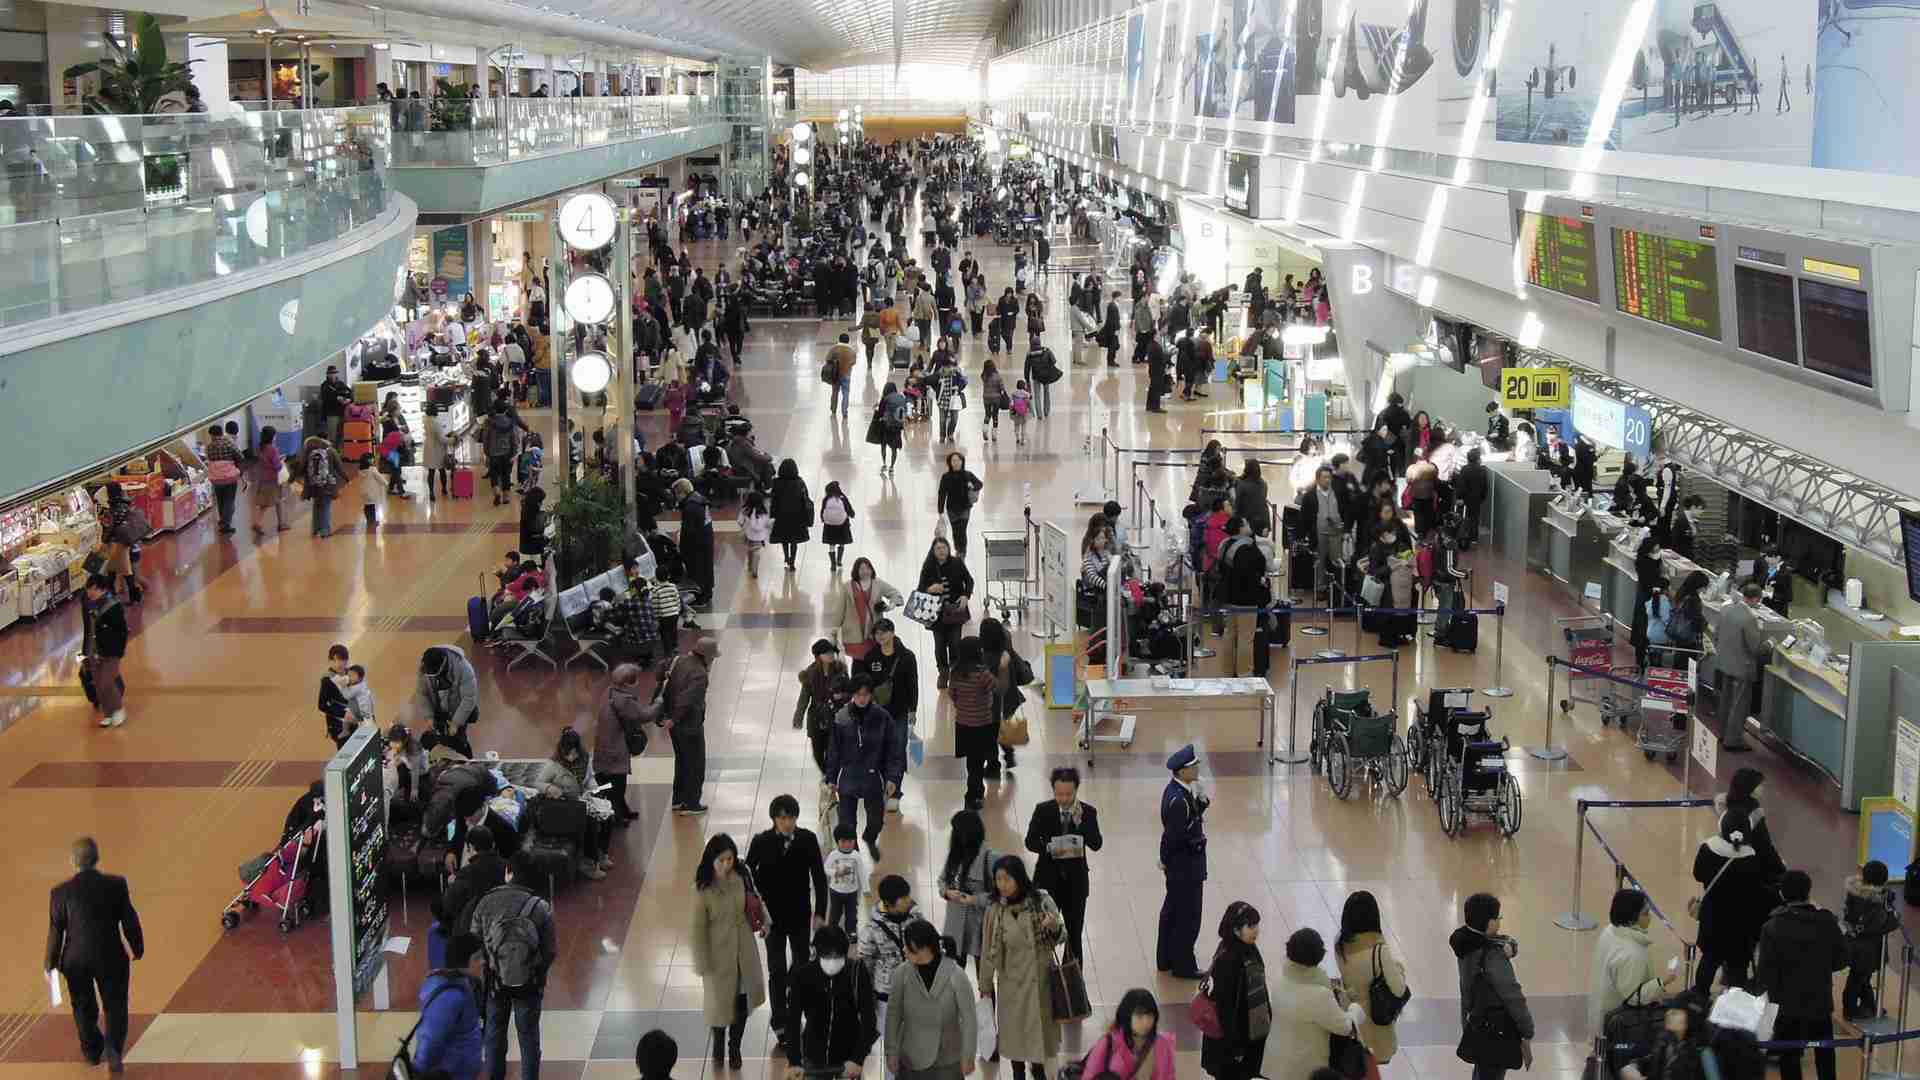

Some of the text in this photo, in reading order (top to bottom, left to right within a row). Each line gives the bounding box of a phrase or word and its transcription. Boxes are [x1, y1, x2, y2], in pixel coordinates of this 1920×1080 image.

[575, 204, 596, 238] 4
[1201, 222, 1213, 238] B
[1352, 264, 1373, 295] B
[1507, 376, 1529, 400] 20
[1626, 418, 1646, 445] 20
